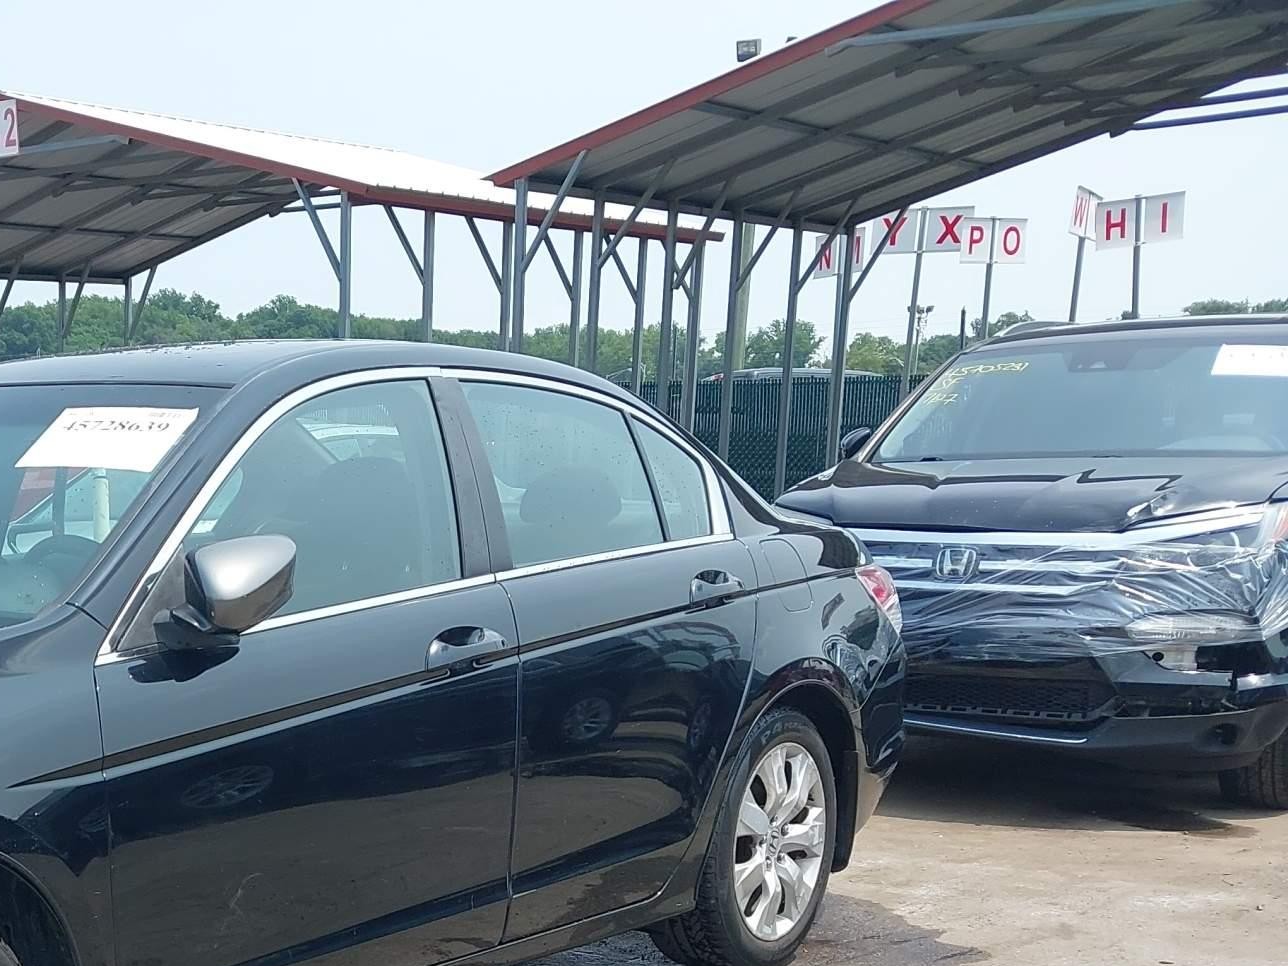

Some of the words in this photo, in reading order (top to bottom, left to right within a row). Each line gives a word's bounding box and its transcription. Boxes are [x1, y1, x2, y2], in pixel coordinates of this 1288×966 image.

[3, 107, 16, 148] 2
[883, 217, 908, 246] Y
[936, 214, 963, 244] X
[1105, 208, 1126, 240] H
[1161, 202, 1168, 233] I
[968, 225, 984, 255] P
